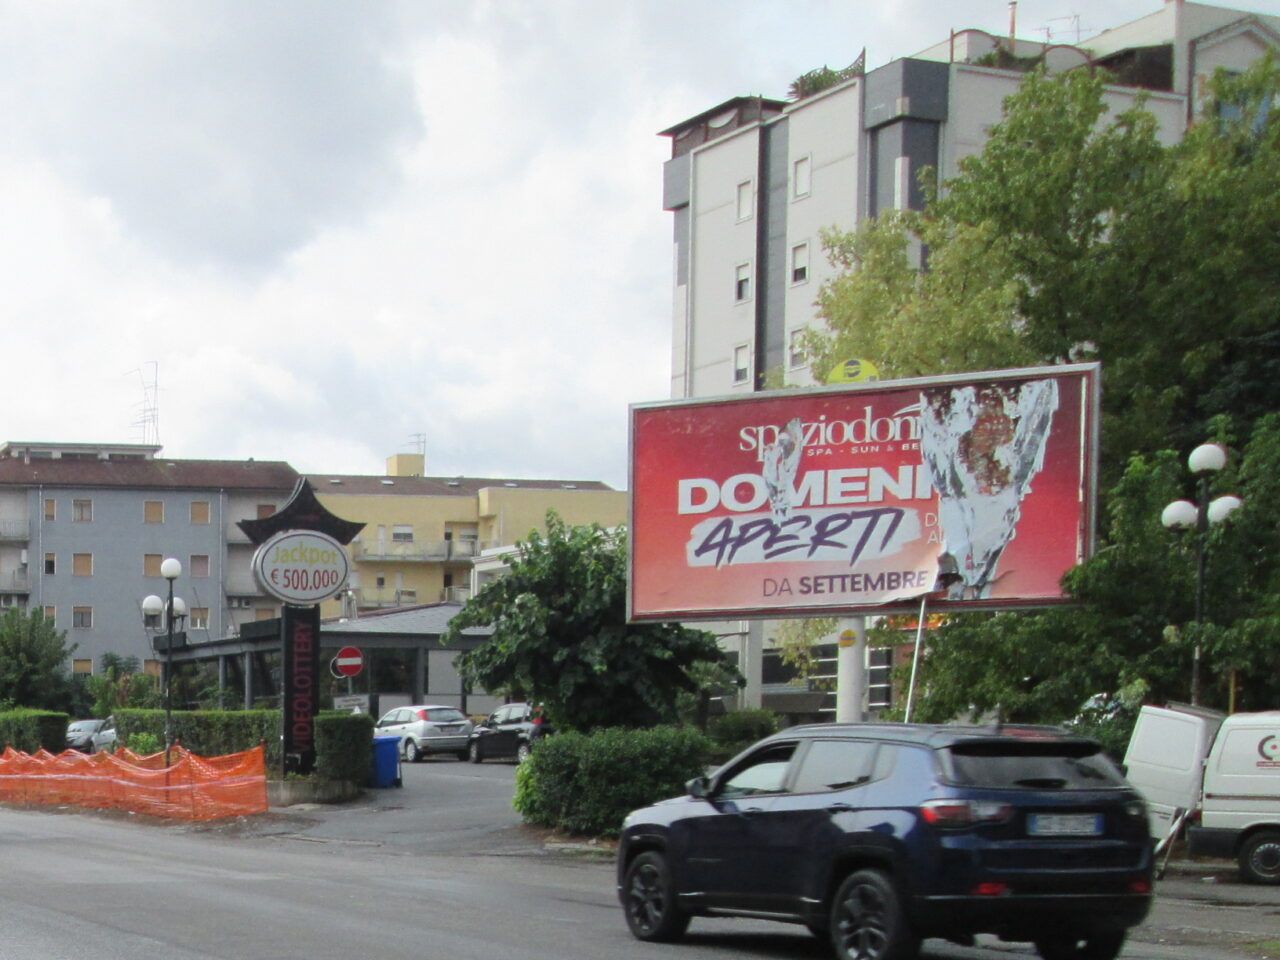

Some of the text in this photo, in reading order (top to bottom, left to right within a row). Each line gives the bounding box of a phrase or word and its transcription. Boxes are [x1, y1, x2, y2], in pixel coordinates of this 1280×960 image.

[807, 447, 833, 457] SPA
[851, 445, 880, 455] SUN
[678, 464, 1032, 515] DOMENI
[694, 507, 906, 569] APERTI
[271, 541, 338, 565] Jackpot
[271, 568, 339, 591] € 500.000
[762, 570, 928, 597] DA SETTEMBRE
[292, 620, 313, 752] VIDEOLOTTERY
